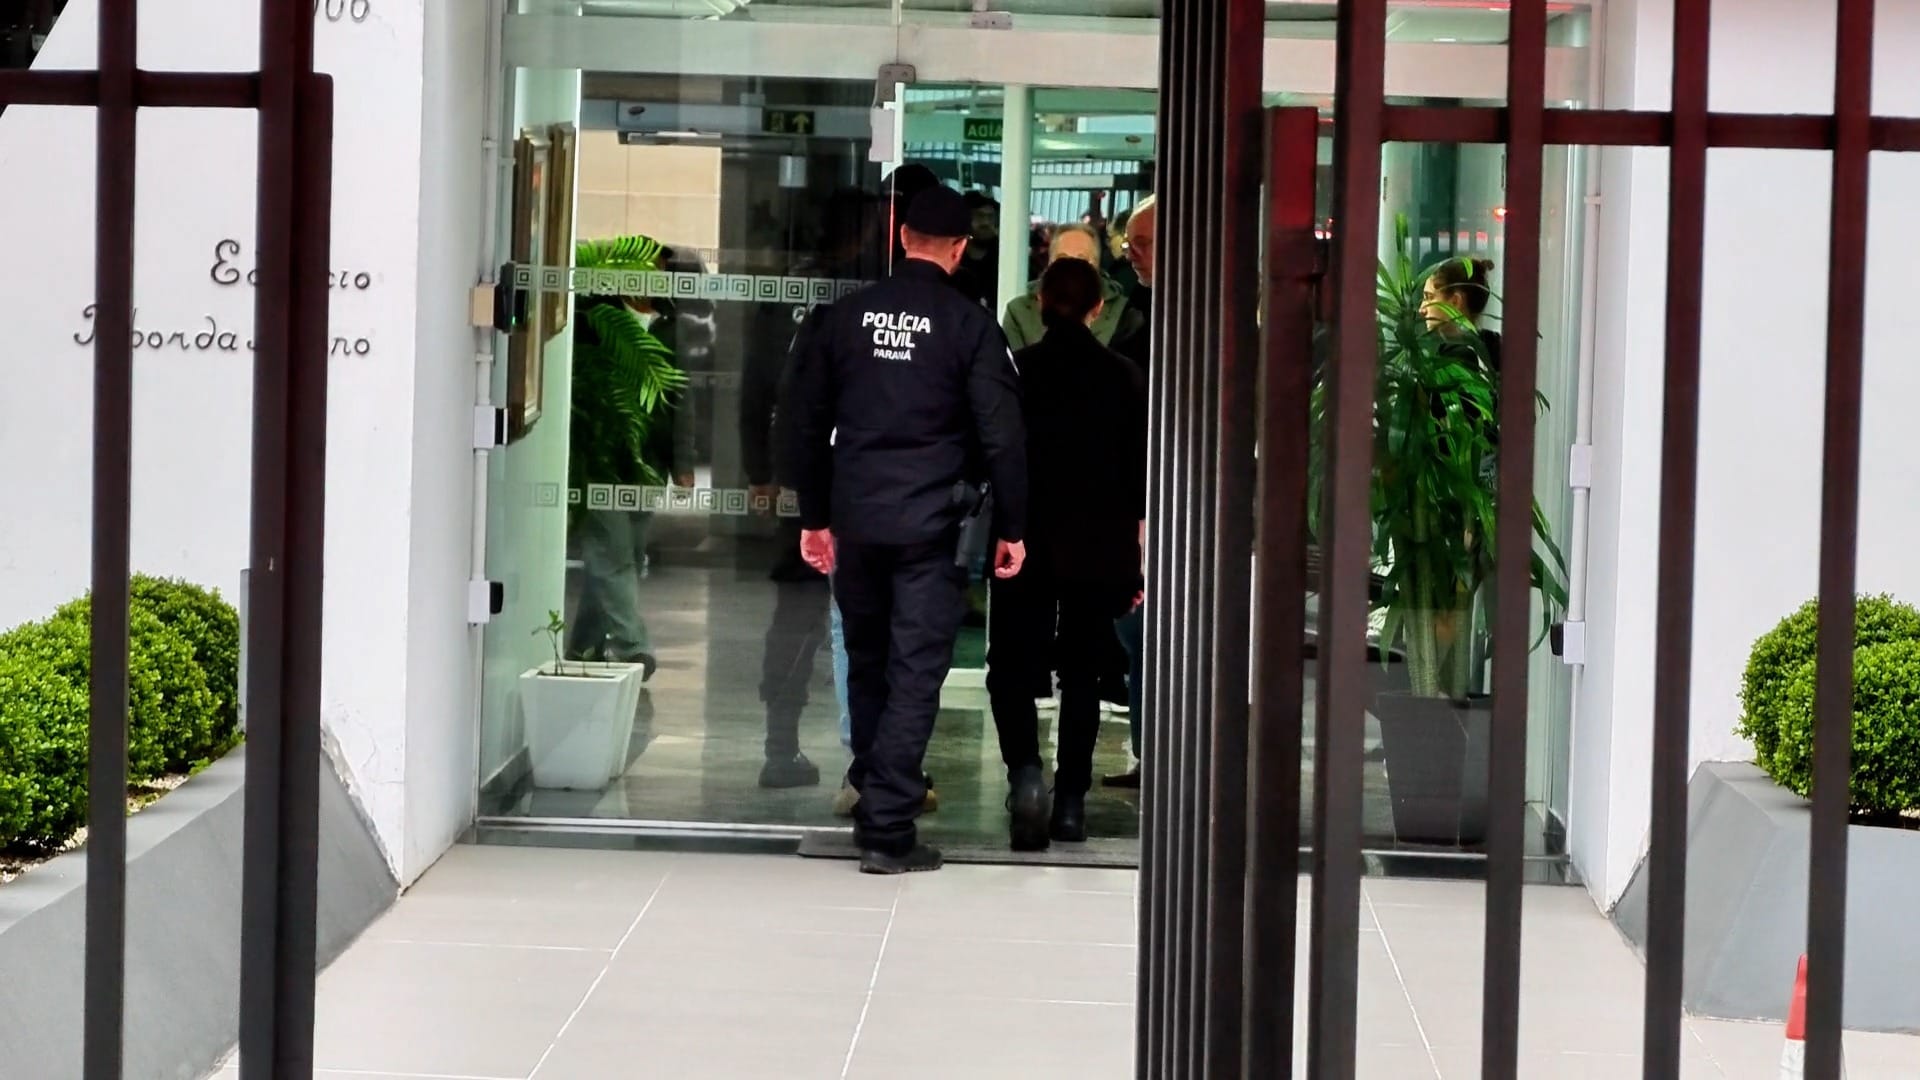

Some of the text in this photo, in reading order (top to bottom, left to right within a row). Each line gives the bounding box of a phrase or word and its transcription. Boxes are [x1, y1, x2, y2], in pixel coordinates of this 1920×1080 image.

[862, 311, 931, 333] POLÍCIA
[872, 328, 916, 348] CIVIL
[873, 348, 912, 361] PARANÁ
